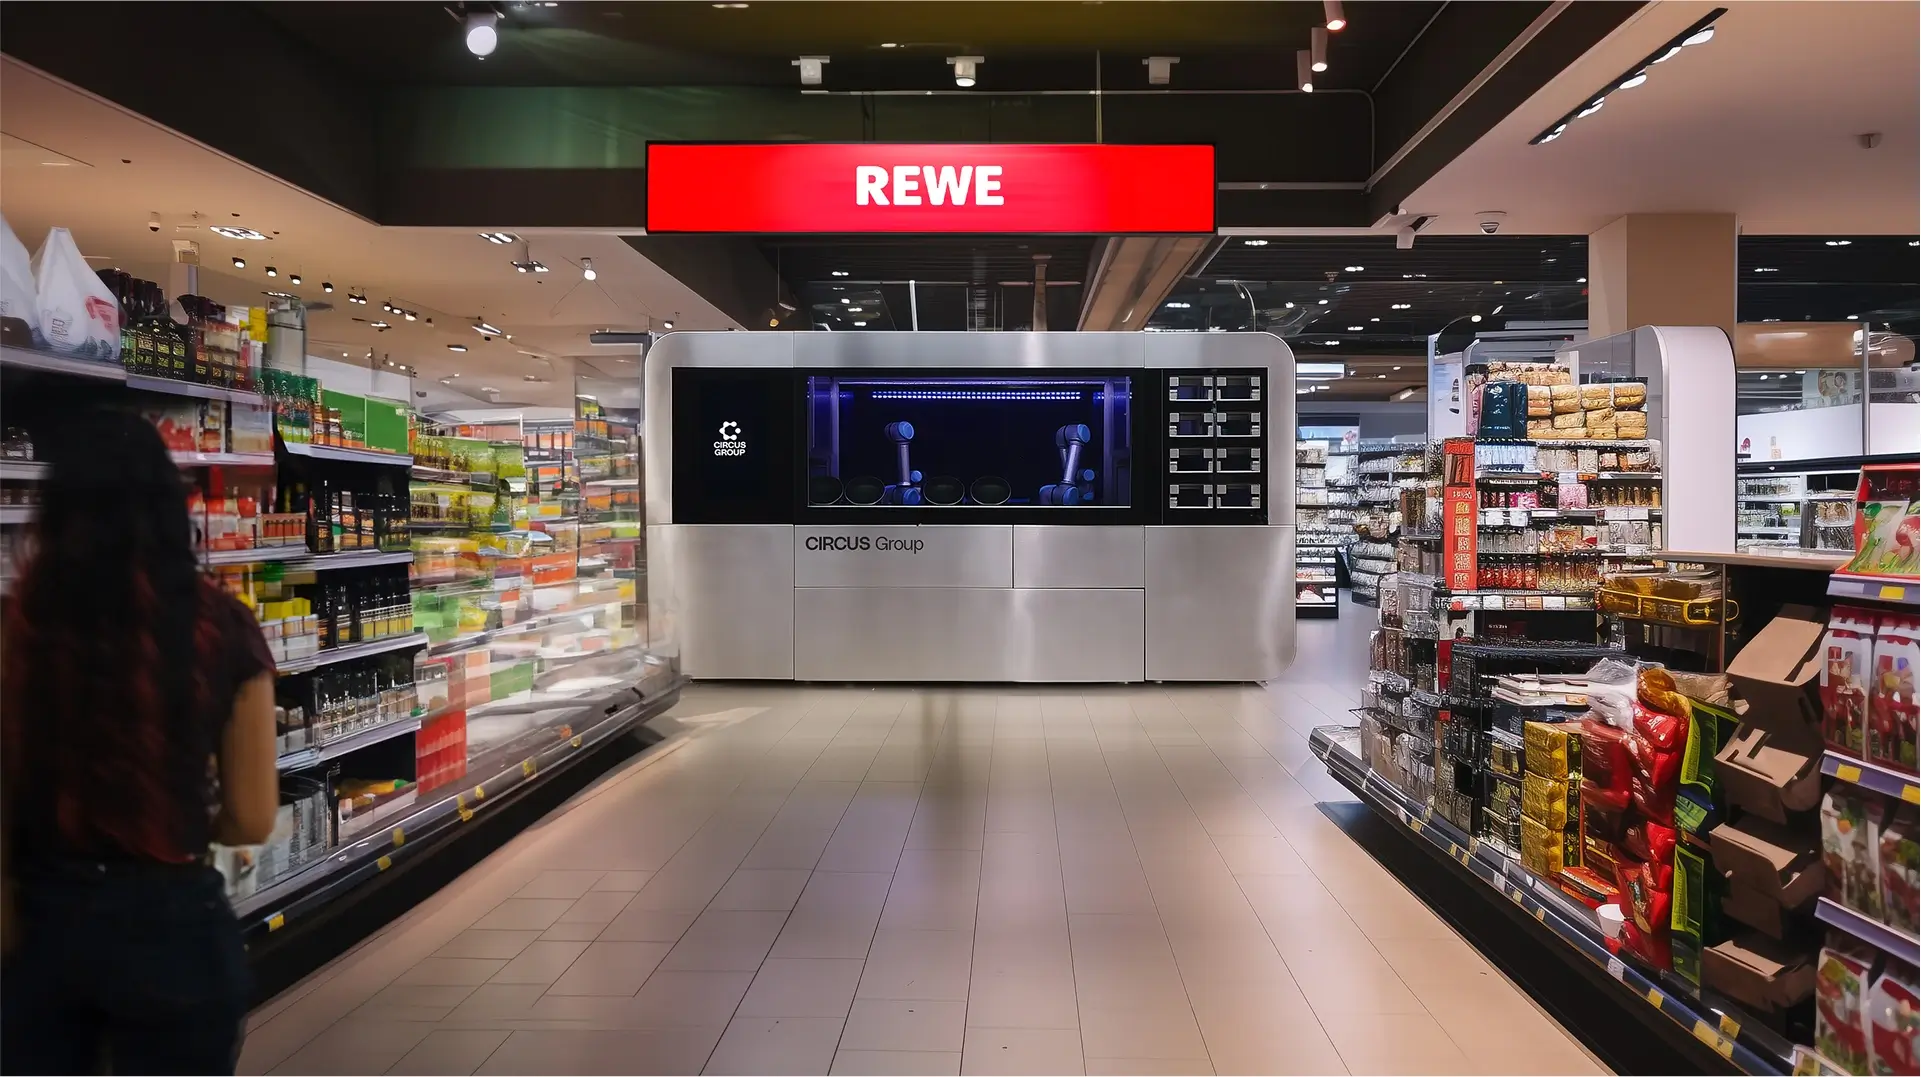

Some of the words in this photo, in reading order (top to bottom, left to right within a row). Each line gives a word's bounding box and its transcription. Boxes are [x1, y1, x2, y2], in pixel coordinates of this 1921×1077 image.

[856, 165, 1004, 206] REWE
[713, 441, 747, 449] CIRCUS
[805, 536, 871, 551] CIRCUS
[875, 536, 924, 554] Group
